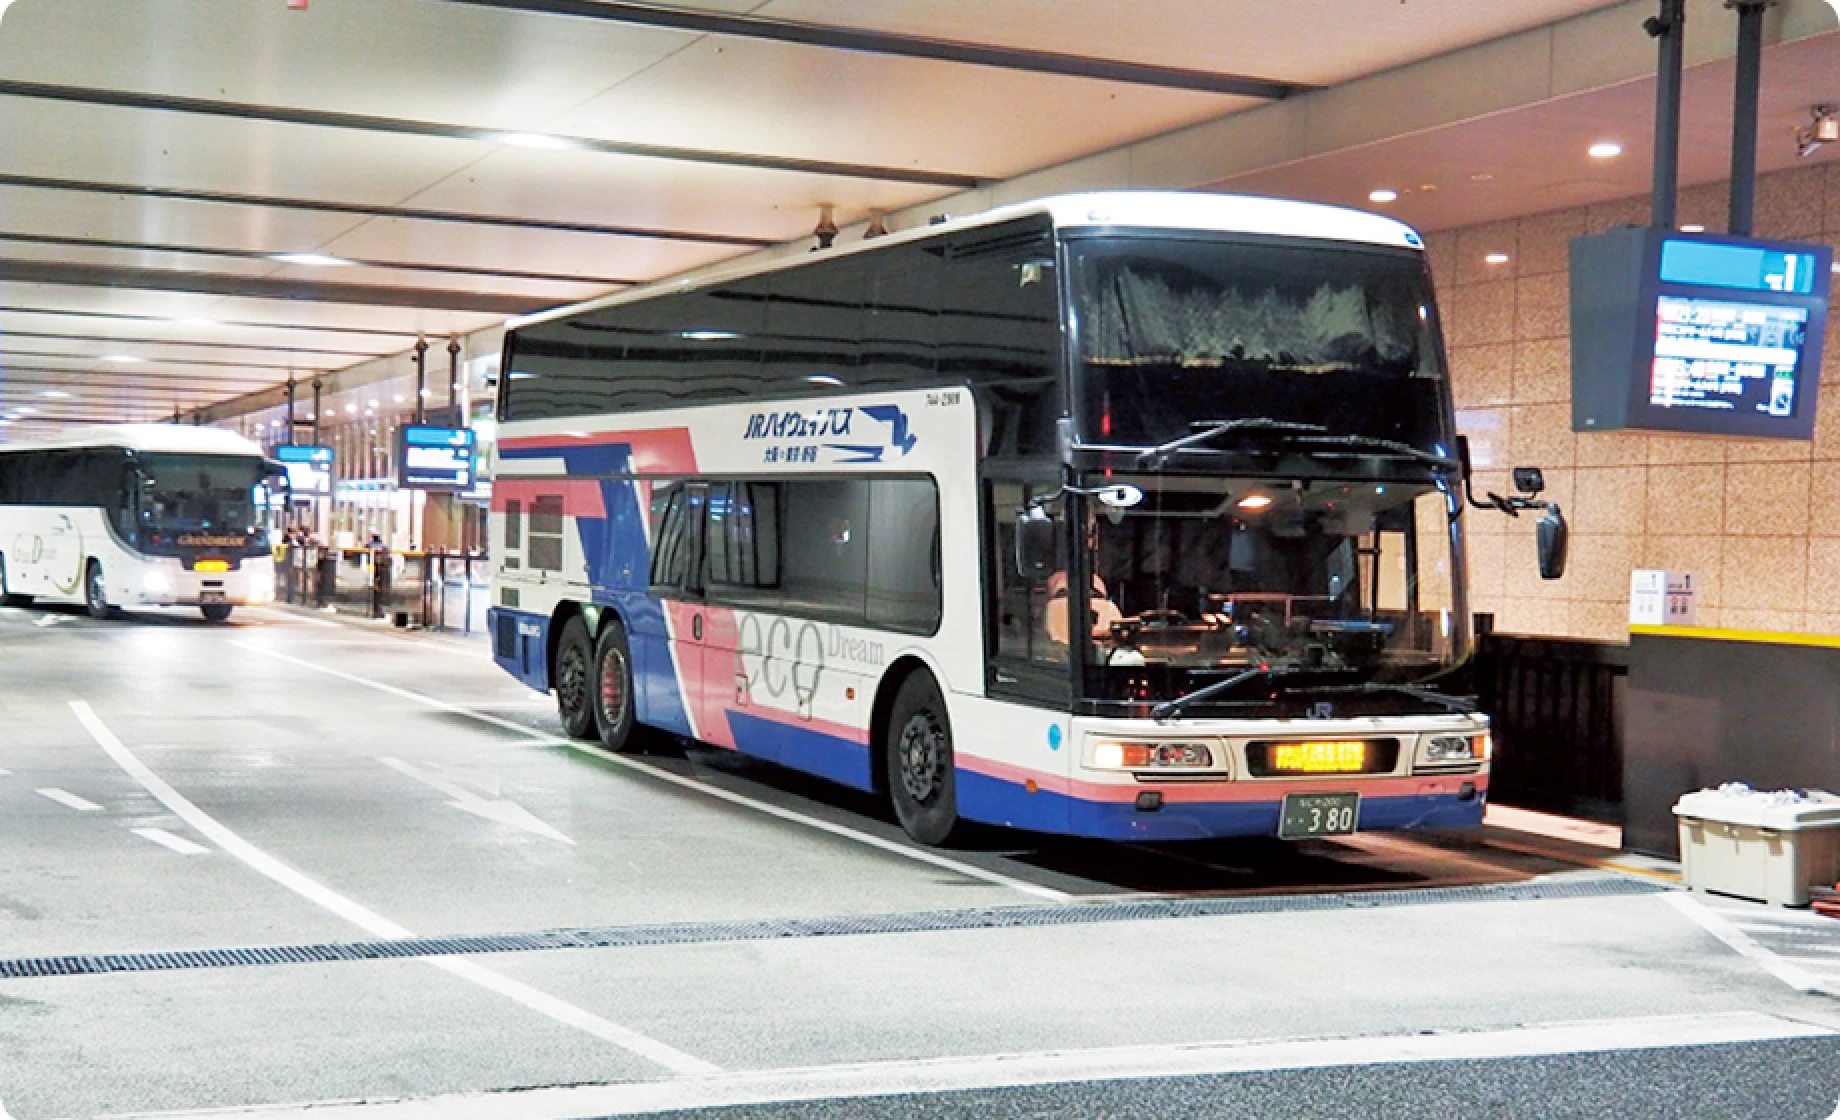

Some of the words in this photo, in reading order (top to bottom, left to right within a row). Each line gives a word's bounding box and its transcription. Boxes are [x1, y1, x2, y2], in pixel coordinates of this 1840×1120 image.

[735, 612, 825, 702] eco
[828, 623, 885, 666] Dream
[1308, 807, 1352, 832] 380
